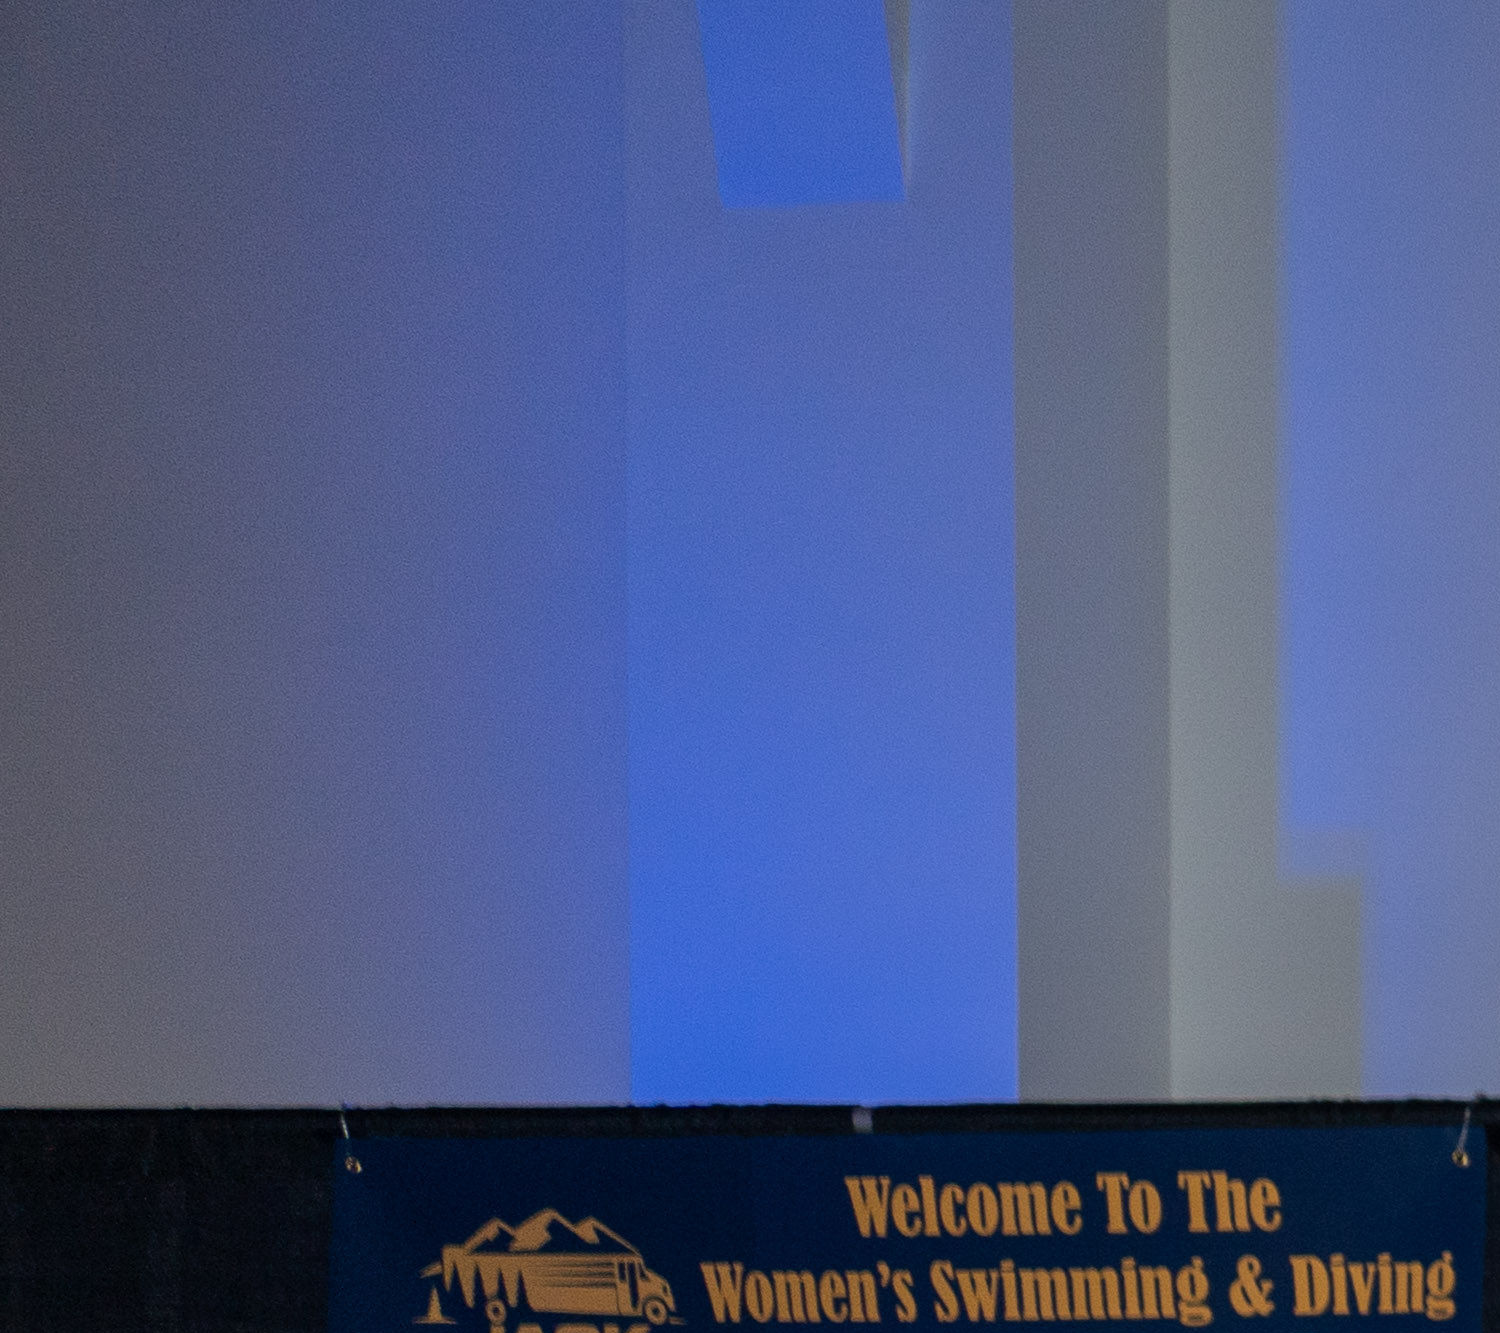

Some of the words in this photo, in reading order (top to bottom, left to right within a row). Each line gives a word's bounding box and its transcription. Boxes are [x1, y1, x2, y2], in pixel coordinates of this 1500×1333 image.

[846, 1173, 1081, 1238] Welcome
[1097, 1170, 1161, 1236] To
[1178, 1170, 1282, 1233] The
[700, 1258, 917, 1326] Women's
[933, 1255, 1213, 1327] Swimming
[1231, 1254, 1275, 1315] &
[1292, 1250, 1456, 1321] Diving
